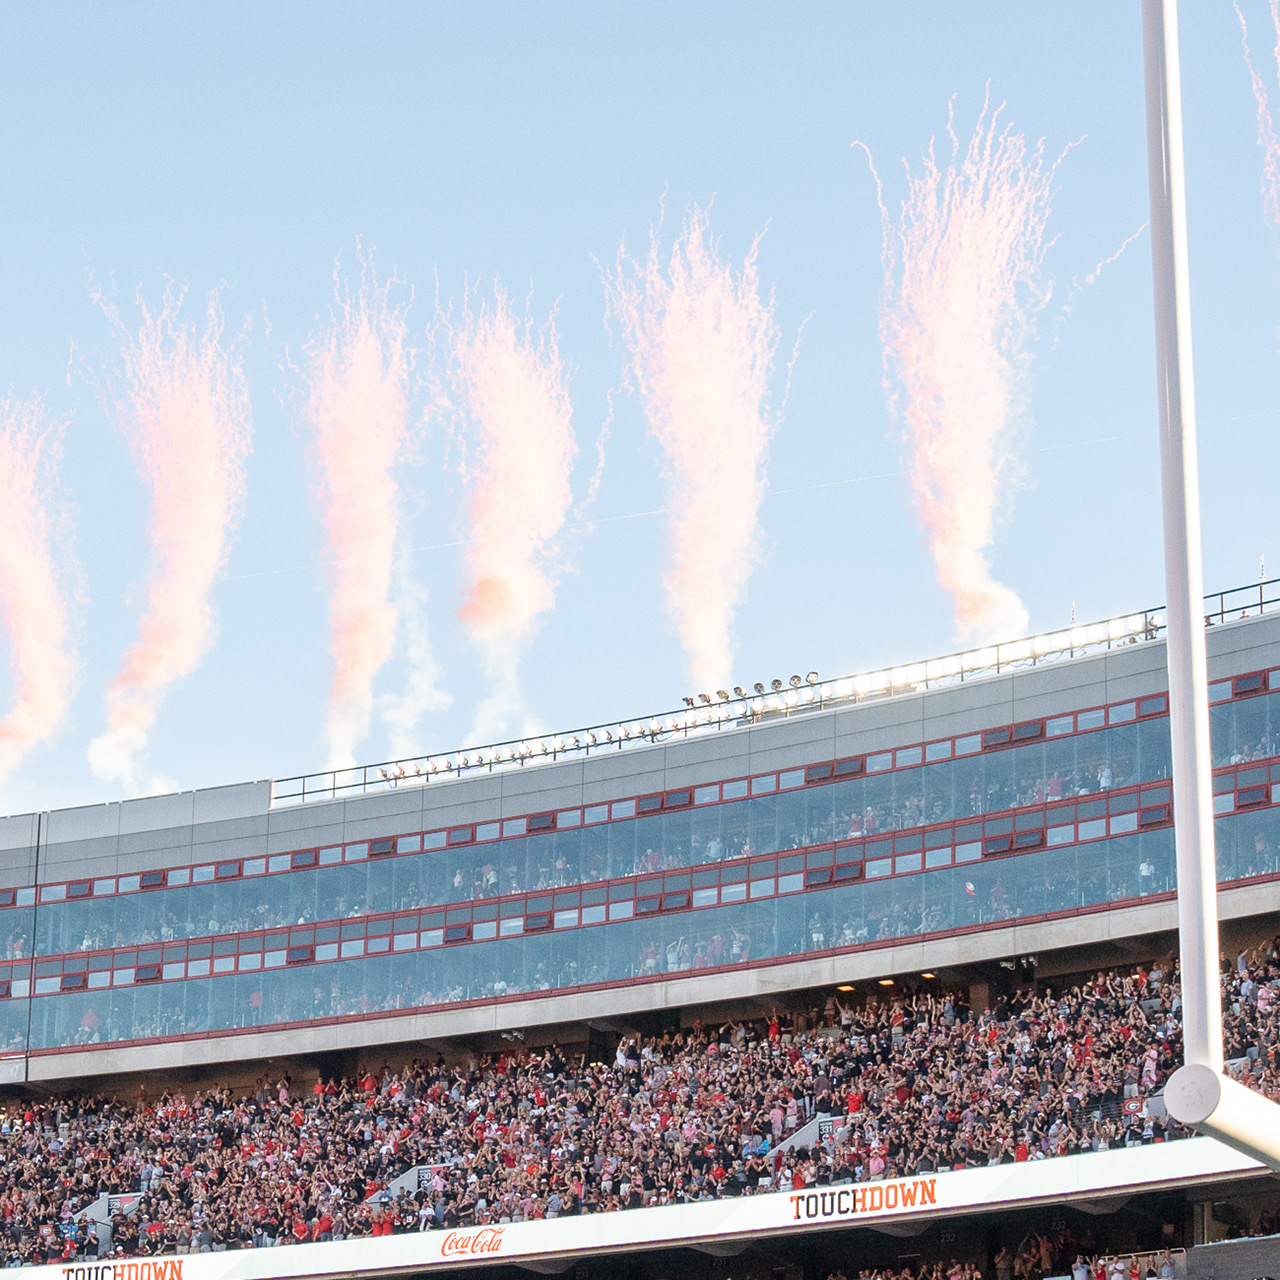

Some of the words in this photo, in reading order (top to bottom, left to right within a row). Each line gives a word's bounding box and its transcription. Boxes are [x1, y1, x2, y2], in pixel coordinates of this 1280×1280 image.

[820, 1125, 833, 1134] 331
[790, 1179, 936, 1220] TOUCHDOWN
[441, 1228, 505, 1256] Coca-Cola
[940, 1233, 956, 1244] 232
[576, 1271, 590, 1280] 231
